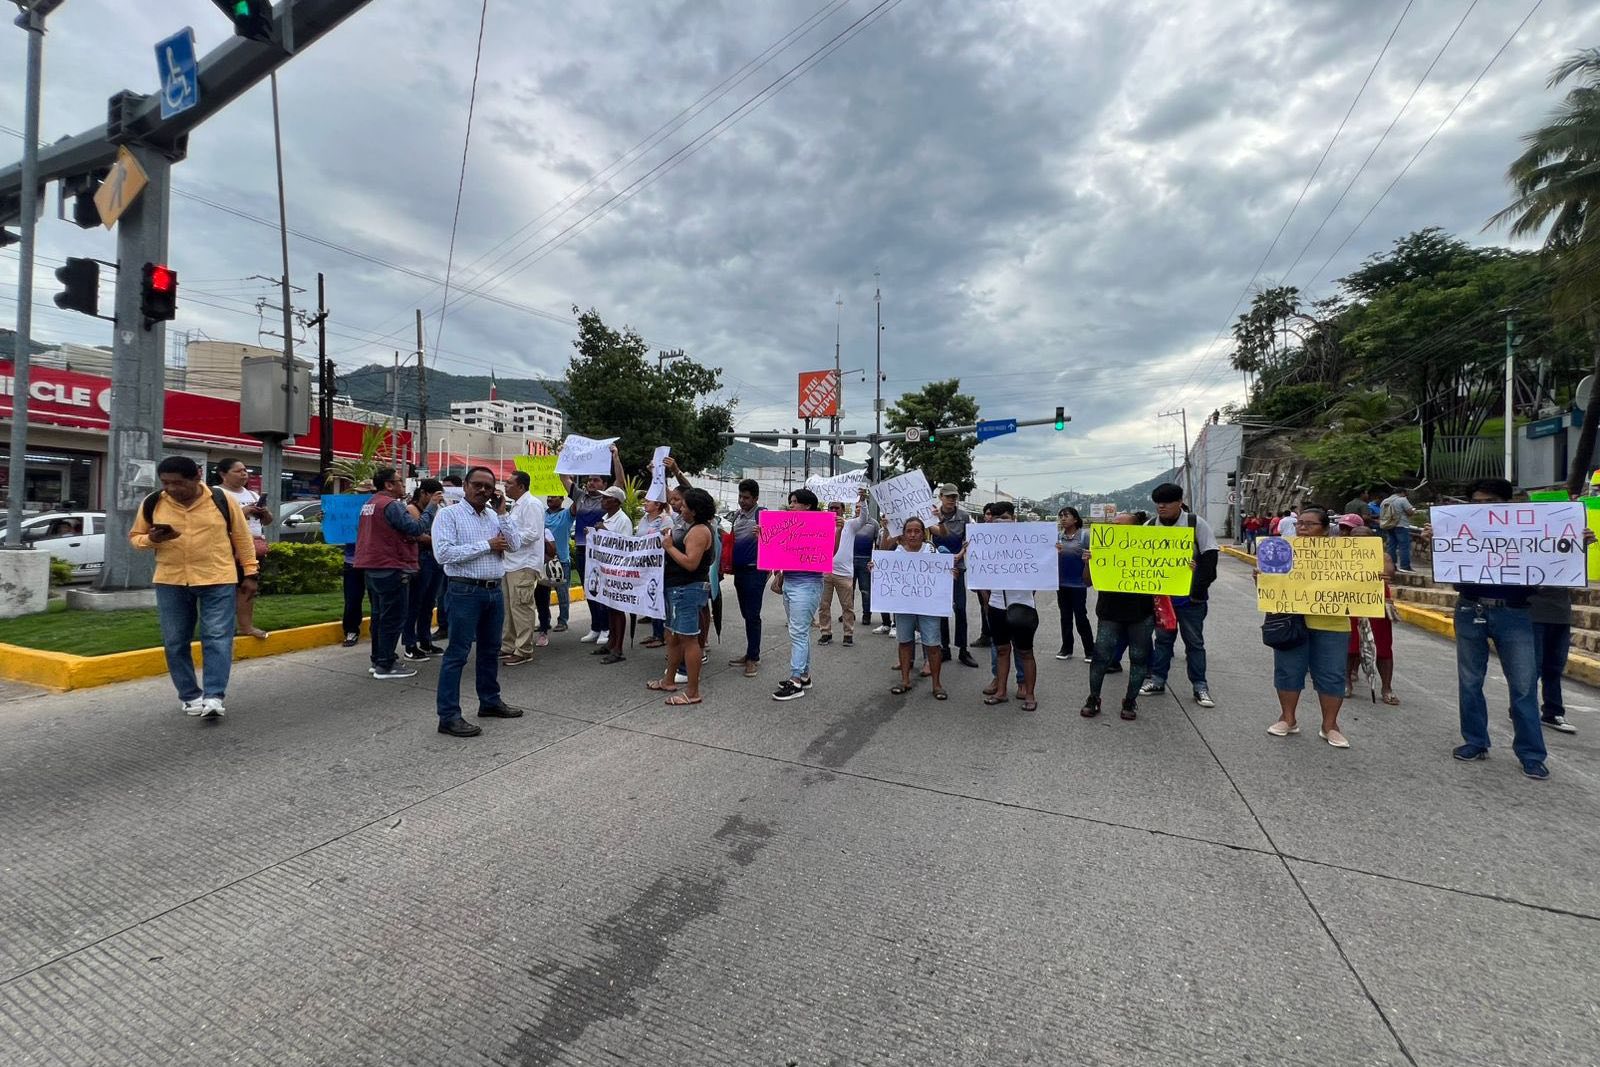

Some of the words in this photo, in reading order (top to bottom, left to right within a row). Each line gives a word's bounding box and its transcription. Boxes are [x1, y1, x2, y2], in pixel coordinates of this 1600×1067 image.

[815, 387, 838, 416] DEPO
[1488, 509, 1535, 525] NO
[1092, 526, 1115, 547] NO
[1458, 523, 1474, 539] A
[969, 533, 1007, 545] APOYO
[1292, 538, 1336, 548] CENTRO
[1343, 538, 1359, 548] DE
[1432, 537, 1585, 554] DESAPARICION
[969, 549, 1034, 560] ALUMNOS
[1351, 549, 1376, 559] PARA
[1487, 551, 1520, 567] DE
[873, 558, 889, 571] NO
[1096, 557, 1106, 567] a
[1113, 554, 1127, 568] la
[1292, 560, 1364, 570] ESTUDIANTES
[979, 562, 1039, 574] ASESORES
[1121, 568, 1169, 580] ESPECIAL
[1288, 571, 1306, 581] CON
[1458, 565, 1546, 585] CAED
[880, 584, 896, 597] DE
[901, 585, 932, 598] CAED
[1118, 580, 1162, 591] (CAED)
[1281, 589, 1288, 600] A
[1295, 590, 1308, 602] LA
[1314, 590, 1383, 604] DESAPARICIÓN
[1276, 601, 1298, 613] DEL
